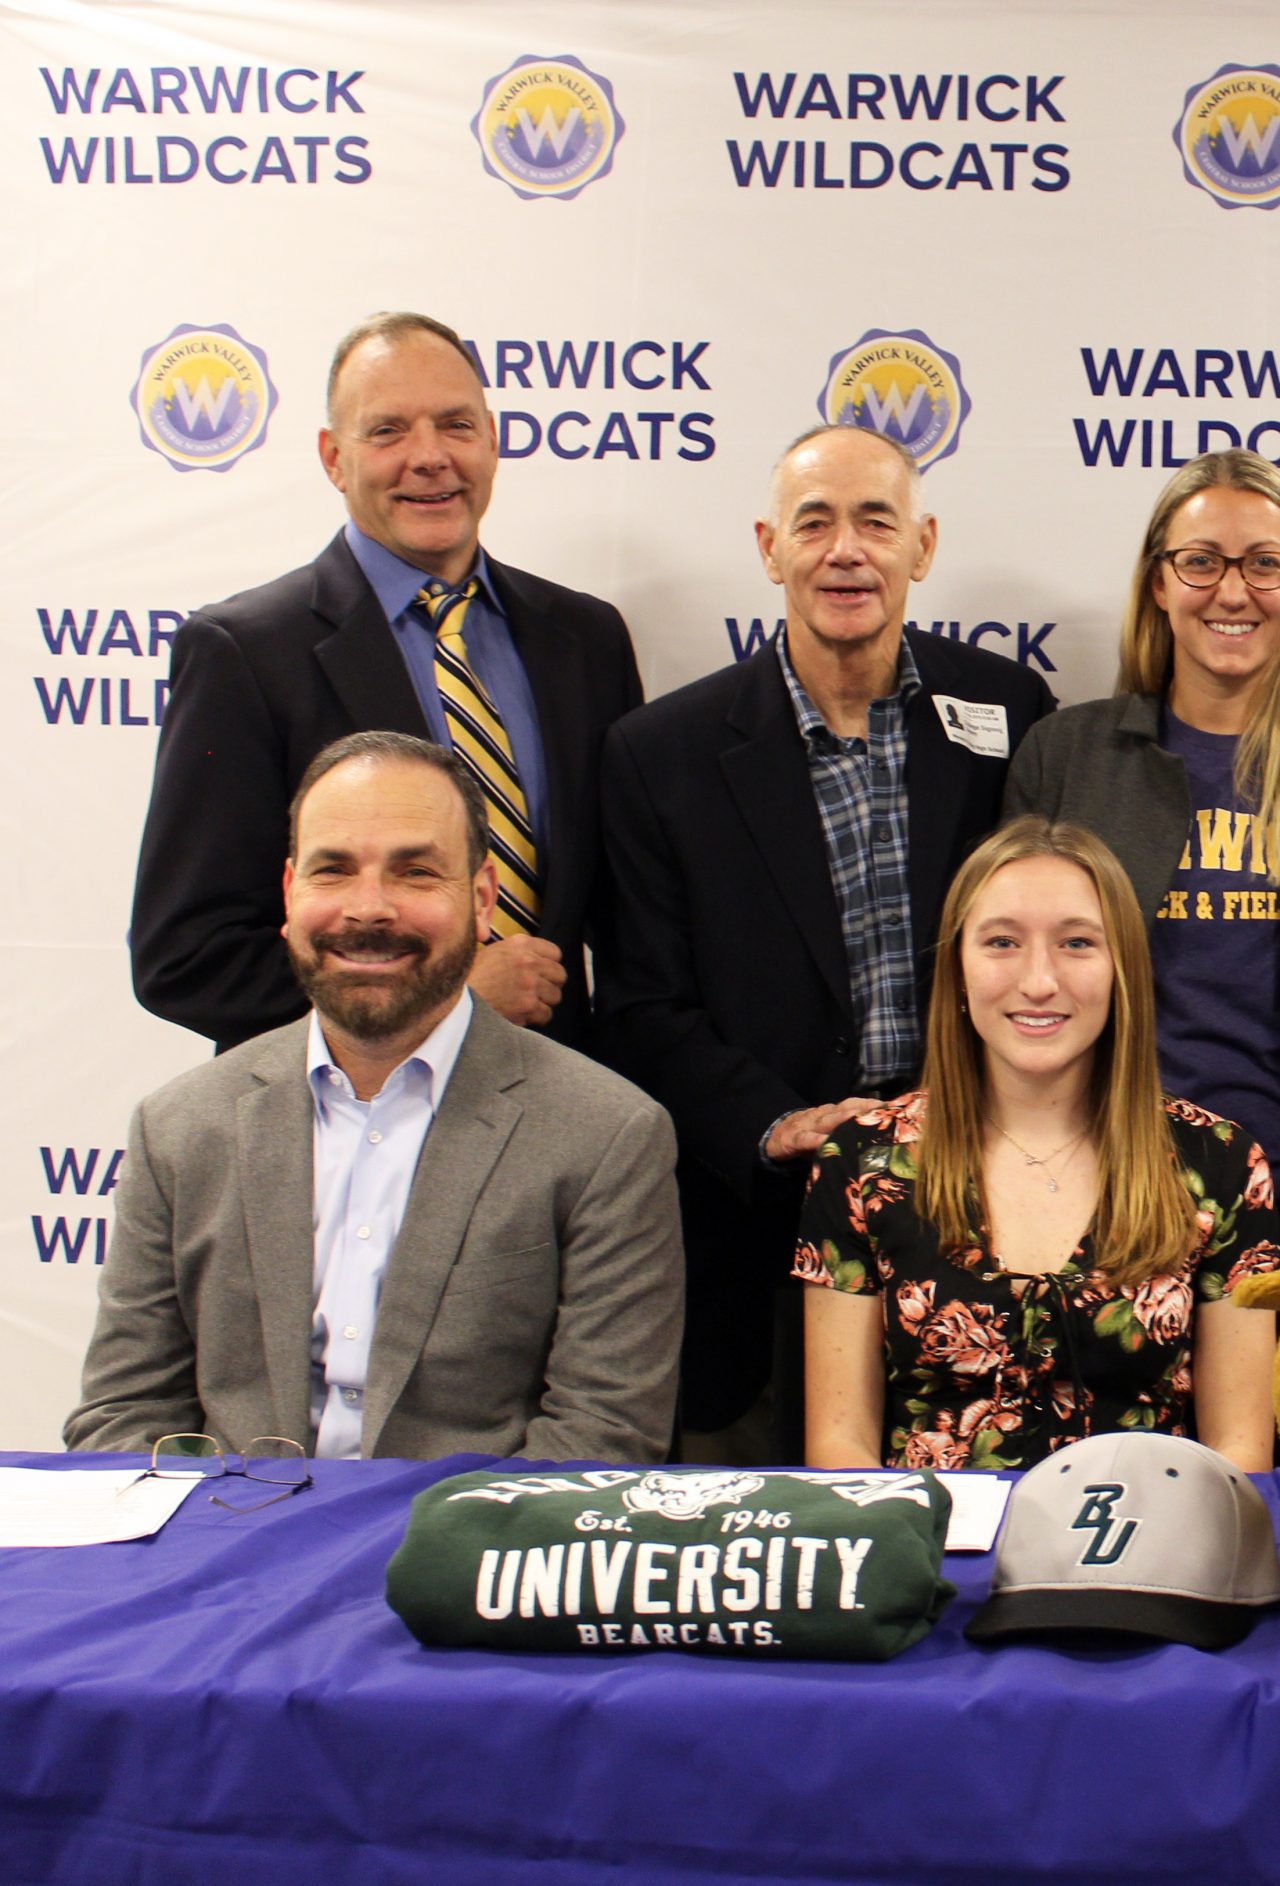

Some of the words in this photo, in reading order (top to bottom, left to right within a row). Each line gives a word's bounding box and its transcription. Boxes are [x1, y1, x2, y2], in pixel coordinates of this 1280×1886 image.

[39, 66, 365, 114] WARWICK
[496, 72, 553, 112] WARWICK
[557, 74, 598, 111] VALLEY
[734, 72, 1066, 122] WARWICK
[1197, 81, 1257, 119] WARWICK
[40, 136, 372, 184] WILDCATS
[726, 139, 1070, 192] WILDCATS
[153, 342, 209, 382] WARWICK
[213, 344, 253, 382] VALLEY
[461, 341, 711, 390] RWICK
[842, 348, 901, 387] WARWICK
[905, 350, 945, 389] VALLEY
[498, 411, 716, 461] DCATS
[1196, 891, 1214, 920] &
[1223, 891, 1280, 920] FIEL
[575, 1509, 632, 1532] Est.
[720, 1508, 792, 1533] 1946
[1071, 1481, 1142, 1567] BU
[475, 1537, 873, 1621] UNIVERSITY
[577, 1621, 776, 1646] BEARCATS
